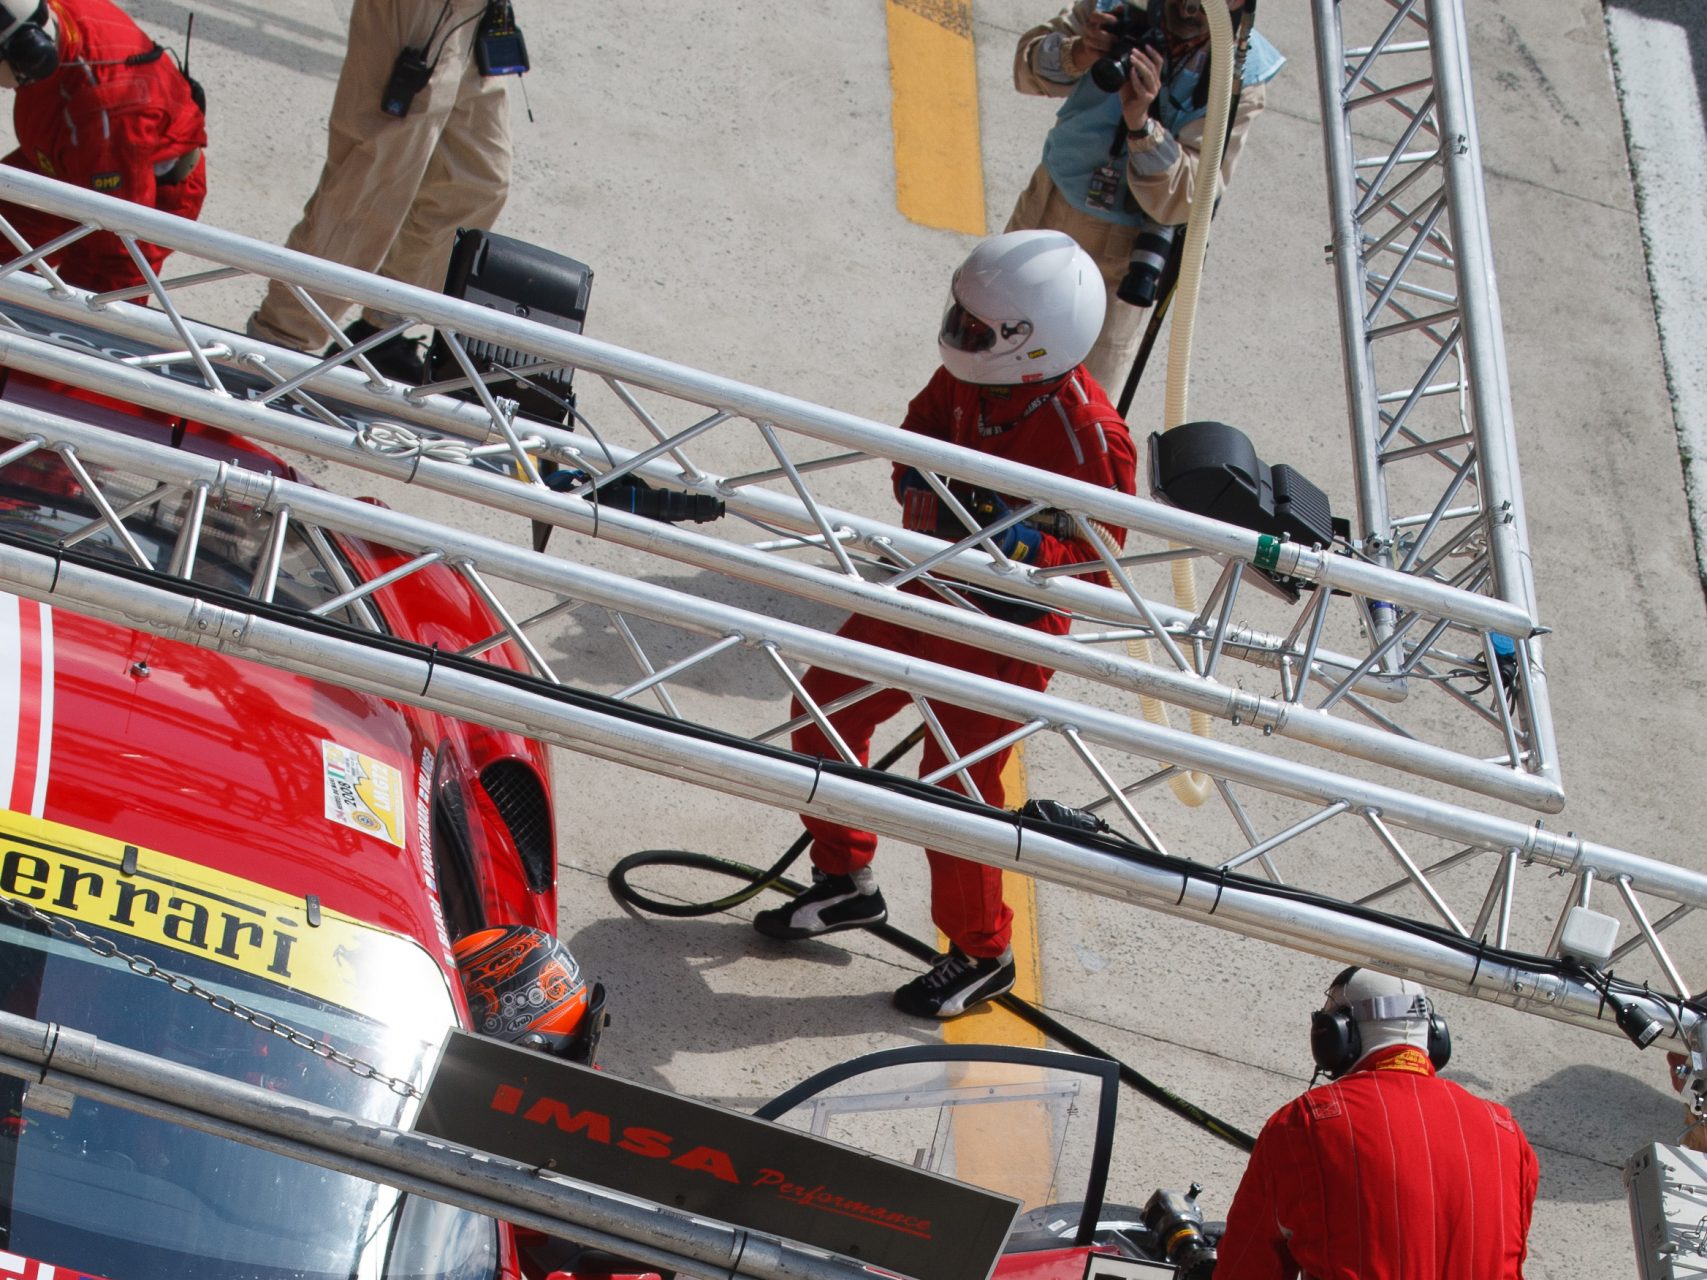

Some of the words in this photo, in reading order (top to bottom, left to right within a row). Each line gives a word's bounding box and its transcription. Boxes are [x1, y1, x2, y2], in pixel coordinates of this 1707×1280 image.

[0, 840, 298, 978] errari
[490, 1083, 740, 1184] IMSA
[752, 1167, 931, 1231] Performance
